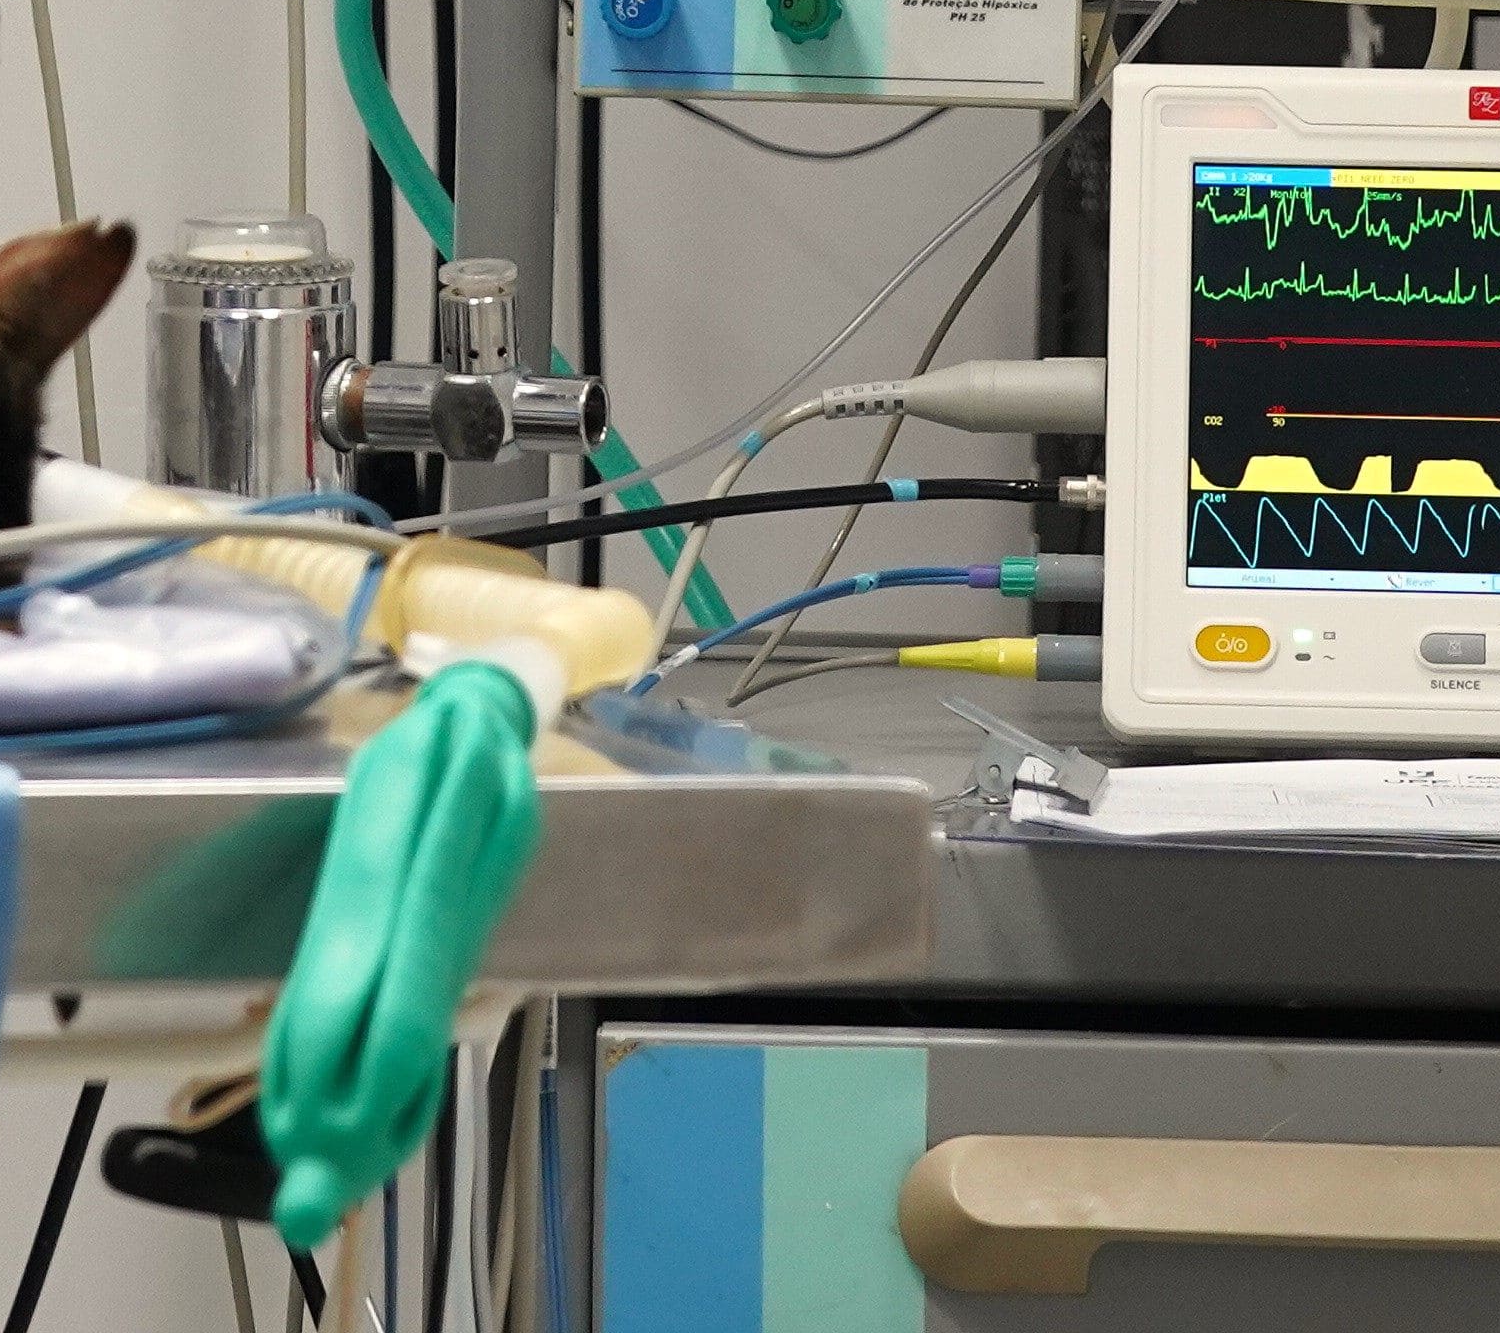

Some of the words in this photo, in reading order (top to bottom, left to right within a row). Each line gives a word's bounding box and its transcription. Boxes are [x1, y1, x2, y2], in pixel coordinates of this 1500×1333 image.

[982, 0, 1038, 10] Hipóxica
[950, 13, 968, 21] PH
[970, 13, 986, 22] 25
[1204, 415, 1223, 426] CO2
[1431, 680, 1481, 691] SILENCE
